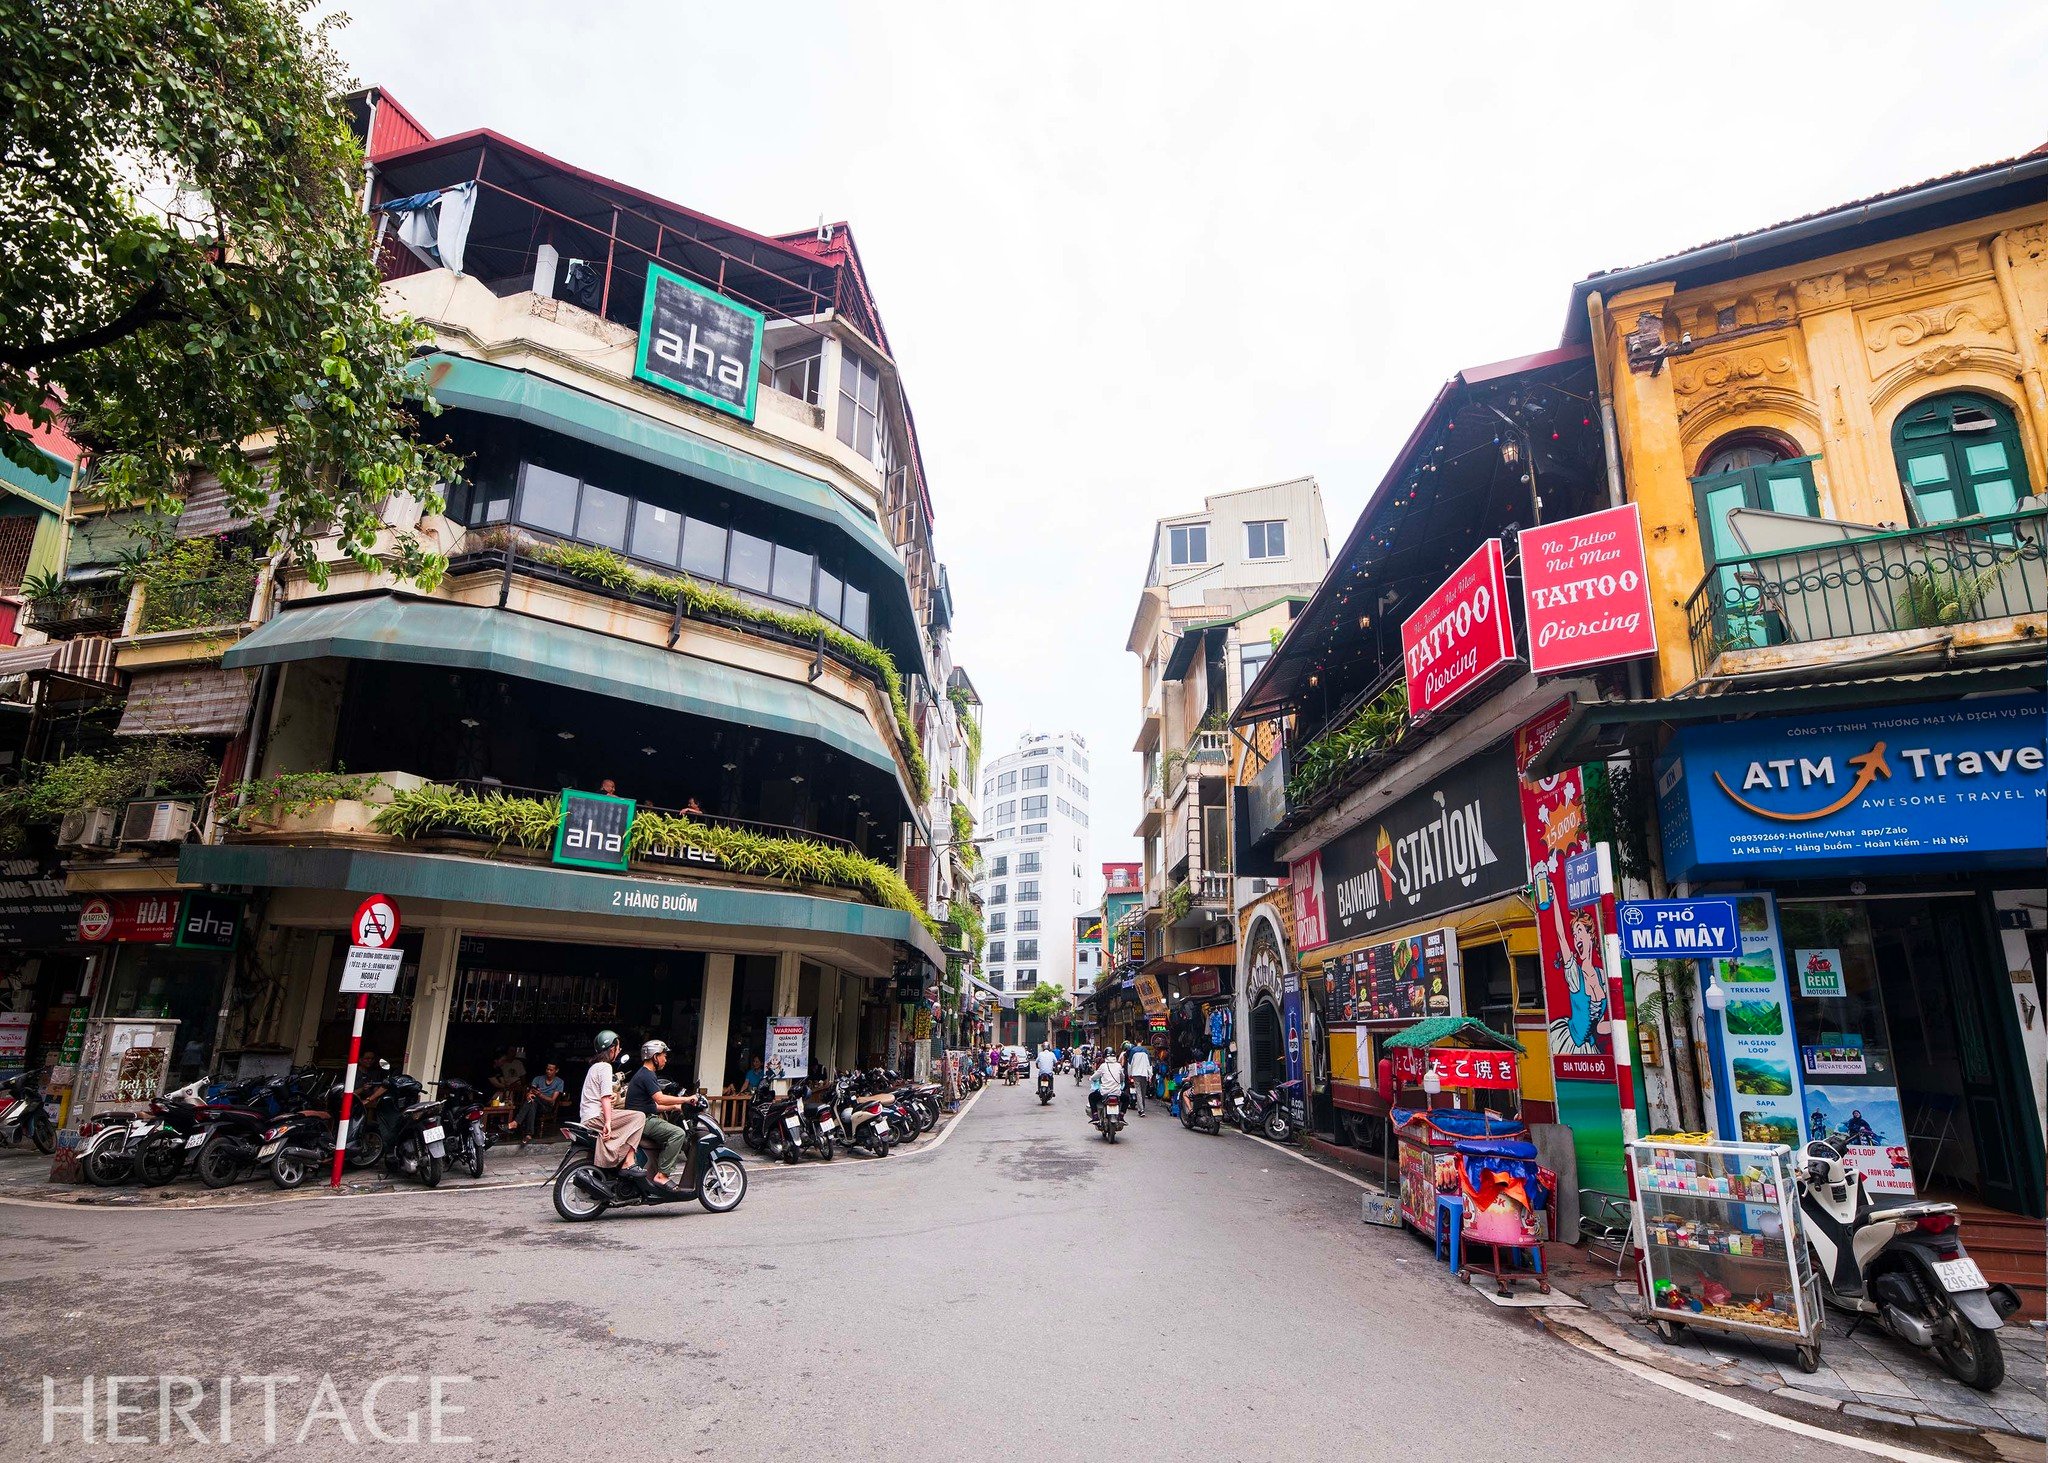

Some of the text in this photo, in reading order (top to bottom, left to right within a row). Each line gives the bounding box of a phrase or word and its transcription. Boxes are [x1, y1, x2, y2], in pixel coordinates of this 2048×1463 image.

[656, 324, 744, 389] aha
[1541, 531, 1616, 556] No Tattoo
[1546, 548, 1621, 573] Not Man
[1532, 570, 1639, 610] TATTOO
[1407, 585, 1491, 679] TATTOO
[1538, 611, 1641, 648] Piercing
[1424, 646, 1477, 705] Piercing
[1787, 727, 1817, 737] CÔNG
[1820, 726, 1833, 734] TY
[1836, 723, 1867, 732] TNHH
[2020, 707, 2037, 716] DU
[1742, 756, 1836, 790] ATM
[1862, 793, 1947, 808] AWESOME
[1956, 790, 2025, 803] TRAVEL
[566, 820, 622, 852] aha
[1396, 799, 1488, 896] STATION
[1795, 843, 1821, 853] Hàng
[1576, 857, 1589, 875] PHỐ
[1580, 877, 1591, 897] DUY
[136, 897, 168, 924] HÒA
[612, 890, 698, 912] 2 HÀNG BUỒM
[188, 910, 234, 936] aha
[1657, 906, 1695, 922] PHỐ
[1632, 922, 1725, 949] MÃ MÂY
[1749, 935, 1769, 943] BOAT
[900, 984, 920, 997] aha
[1730, 986, 1770, 994] TREKKING
[1807, 974, 1836, 988] RENT
[1806, 988, 1840, 996] MOTORBIKE
[1751, 1040, 1776, 1048] GIANG
[1563, 1060, 1606, 1075] BIA TƯƠI 6 ĐỘ
[1859, 1148, 1876, 1157] LOOP
[1867, 1168, 1882, 1176] FROM
[1876, 1180, 1886, 1188] ALL
[1368, 1201, 1384, 1212] Tiger
